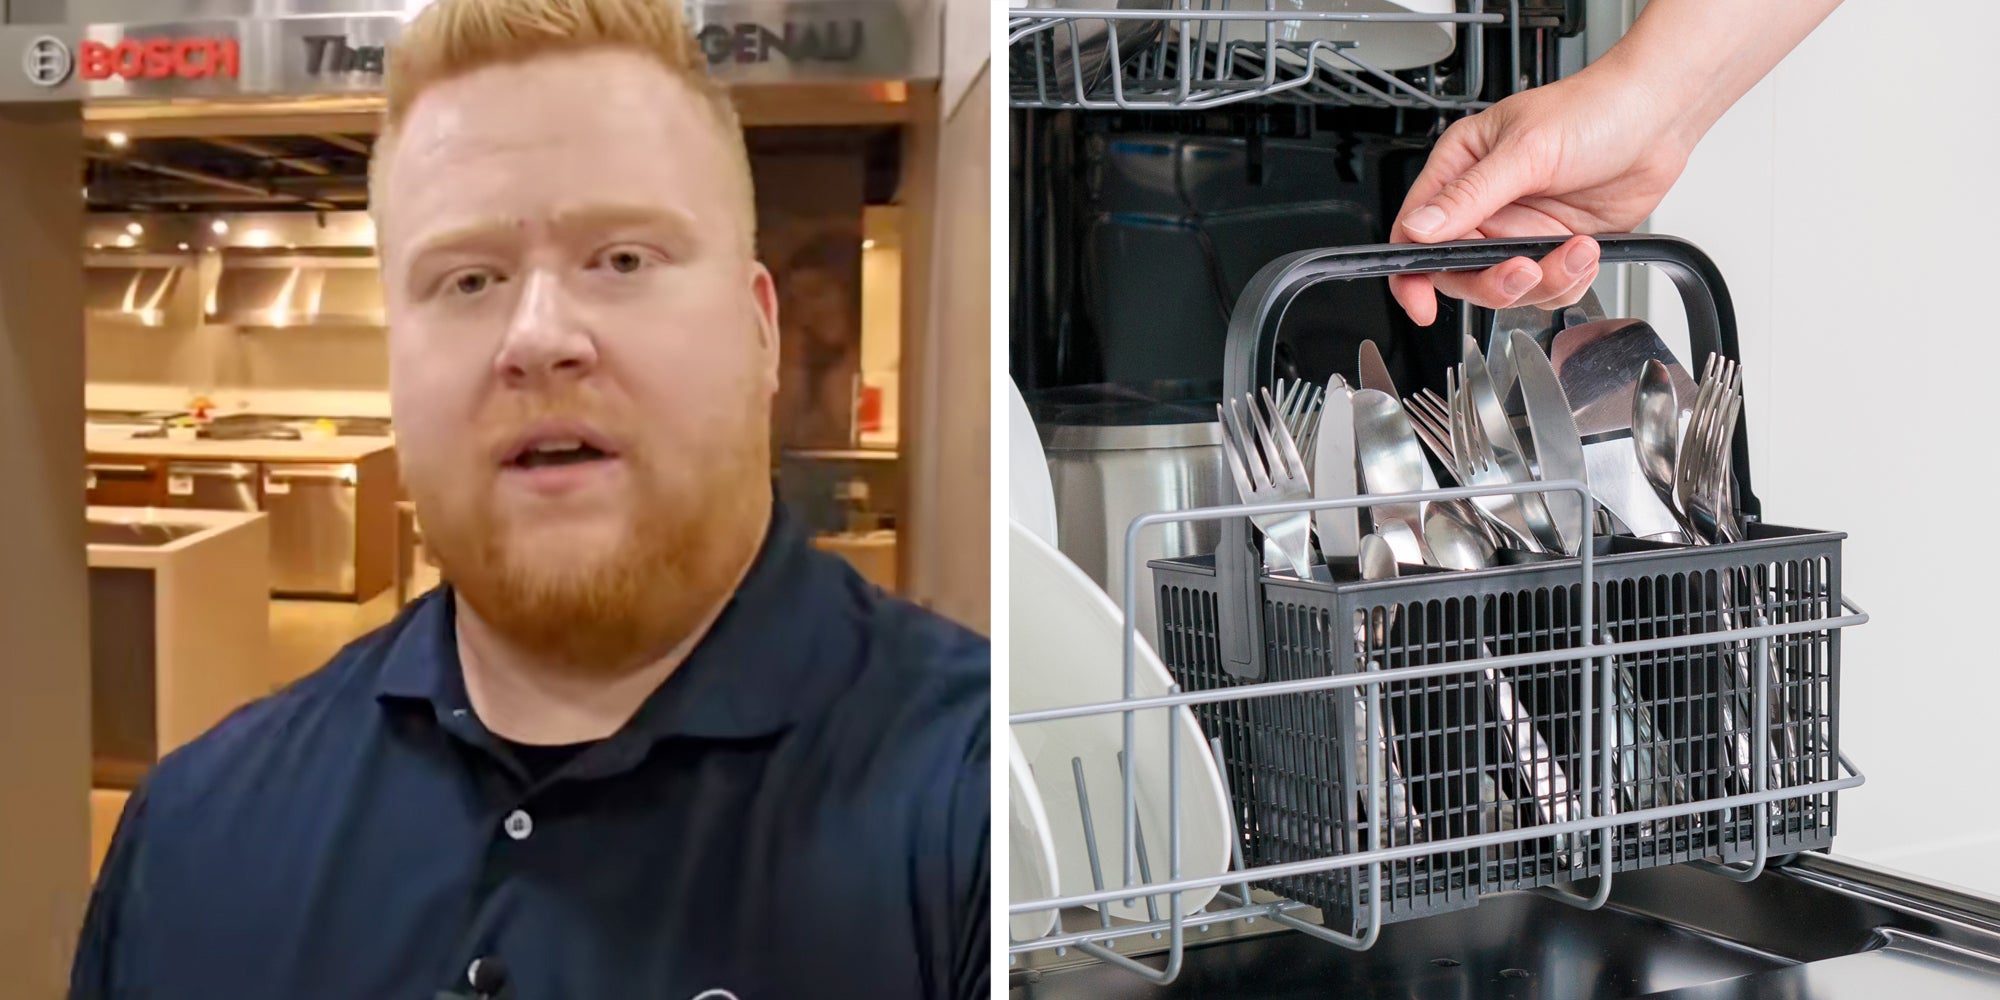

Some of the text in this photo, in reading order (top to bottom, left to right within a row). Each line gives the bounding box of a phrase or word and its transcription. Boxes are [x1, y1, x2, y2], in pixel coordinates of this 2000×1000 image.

[79, 37, 240, 80] BOSCH
[303, 35, 384, 76] The
[697, 20, 864, 64] GENAU
